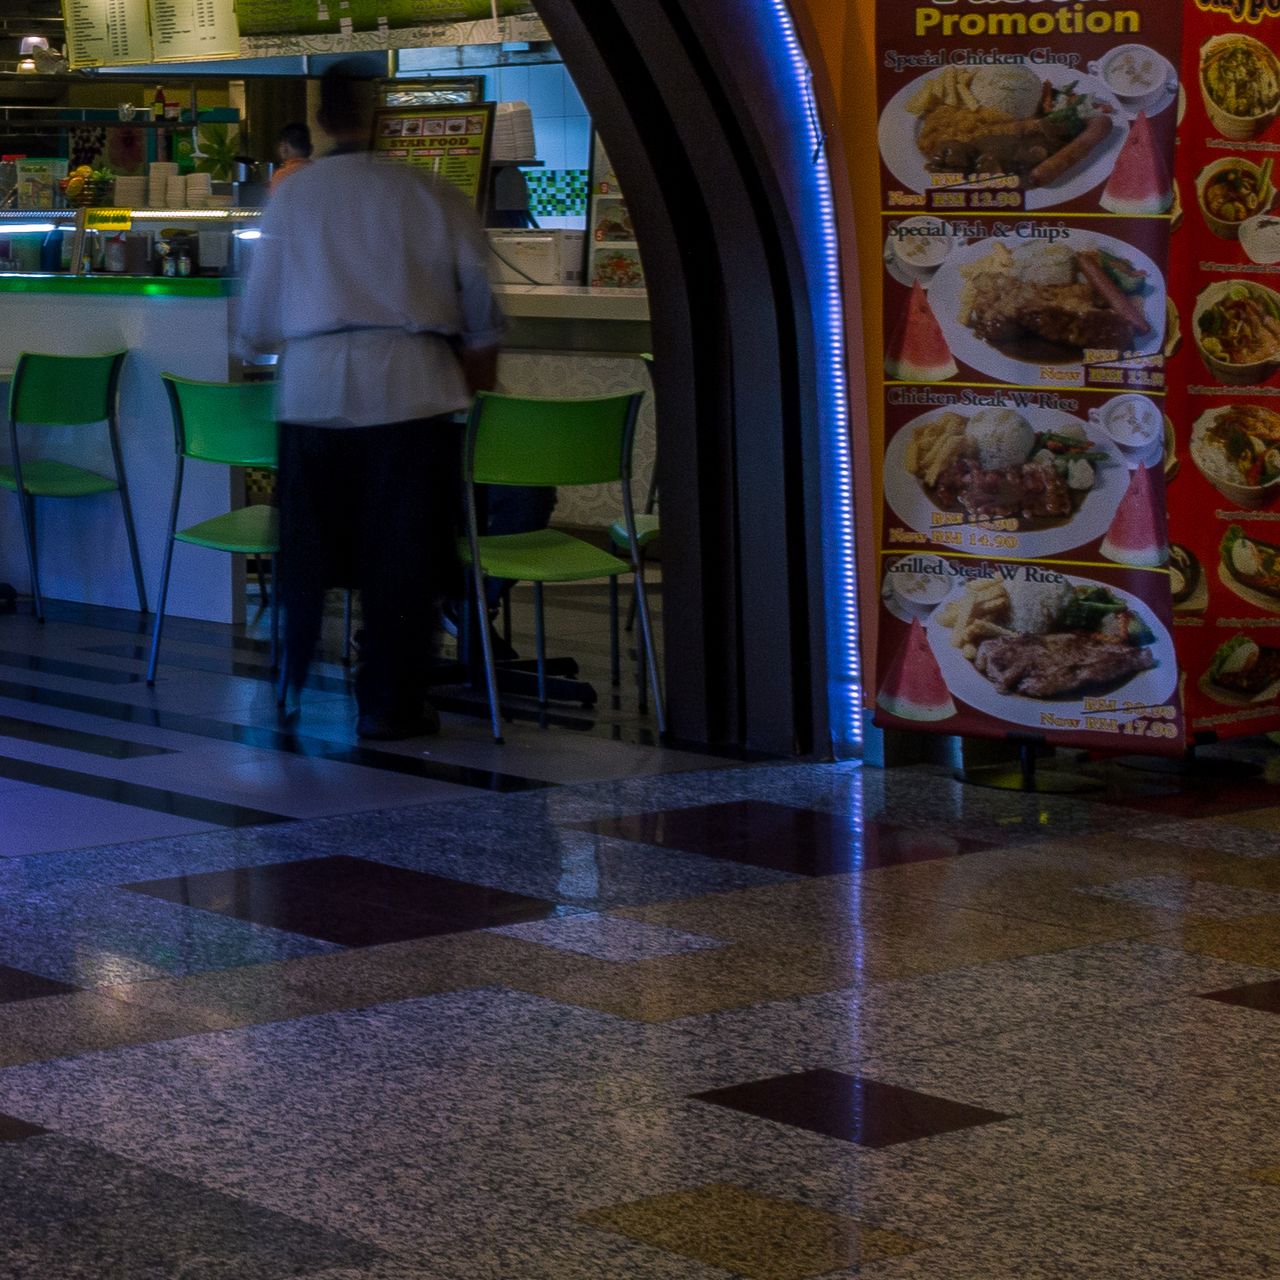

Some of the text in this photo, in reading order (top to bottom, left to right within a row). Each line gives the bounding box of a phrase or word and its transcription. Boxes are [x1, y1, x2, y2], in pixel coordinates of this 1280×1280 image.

[915, 6, 1140, 37] Promotion
[884, 48, 1080, 72] Special Chicken Chop
[390, 137, 470, 148] STAR FOOD
[888, 220, 1070, 241] Special Fish & Chip's
[887, 388, 957, 406] Chicken
[961, 390, 1007, 408] Steak
[1038, 392, 1079, 412] Rice
[887, 557, 1064, 584] Grilled Steak W Rice
